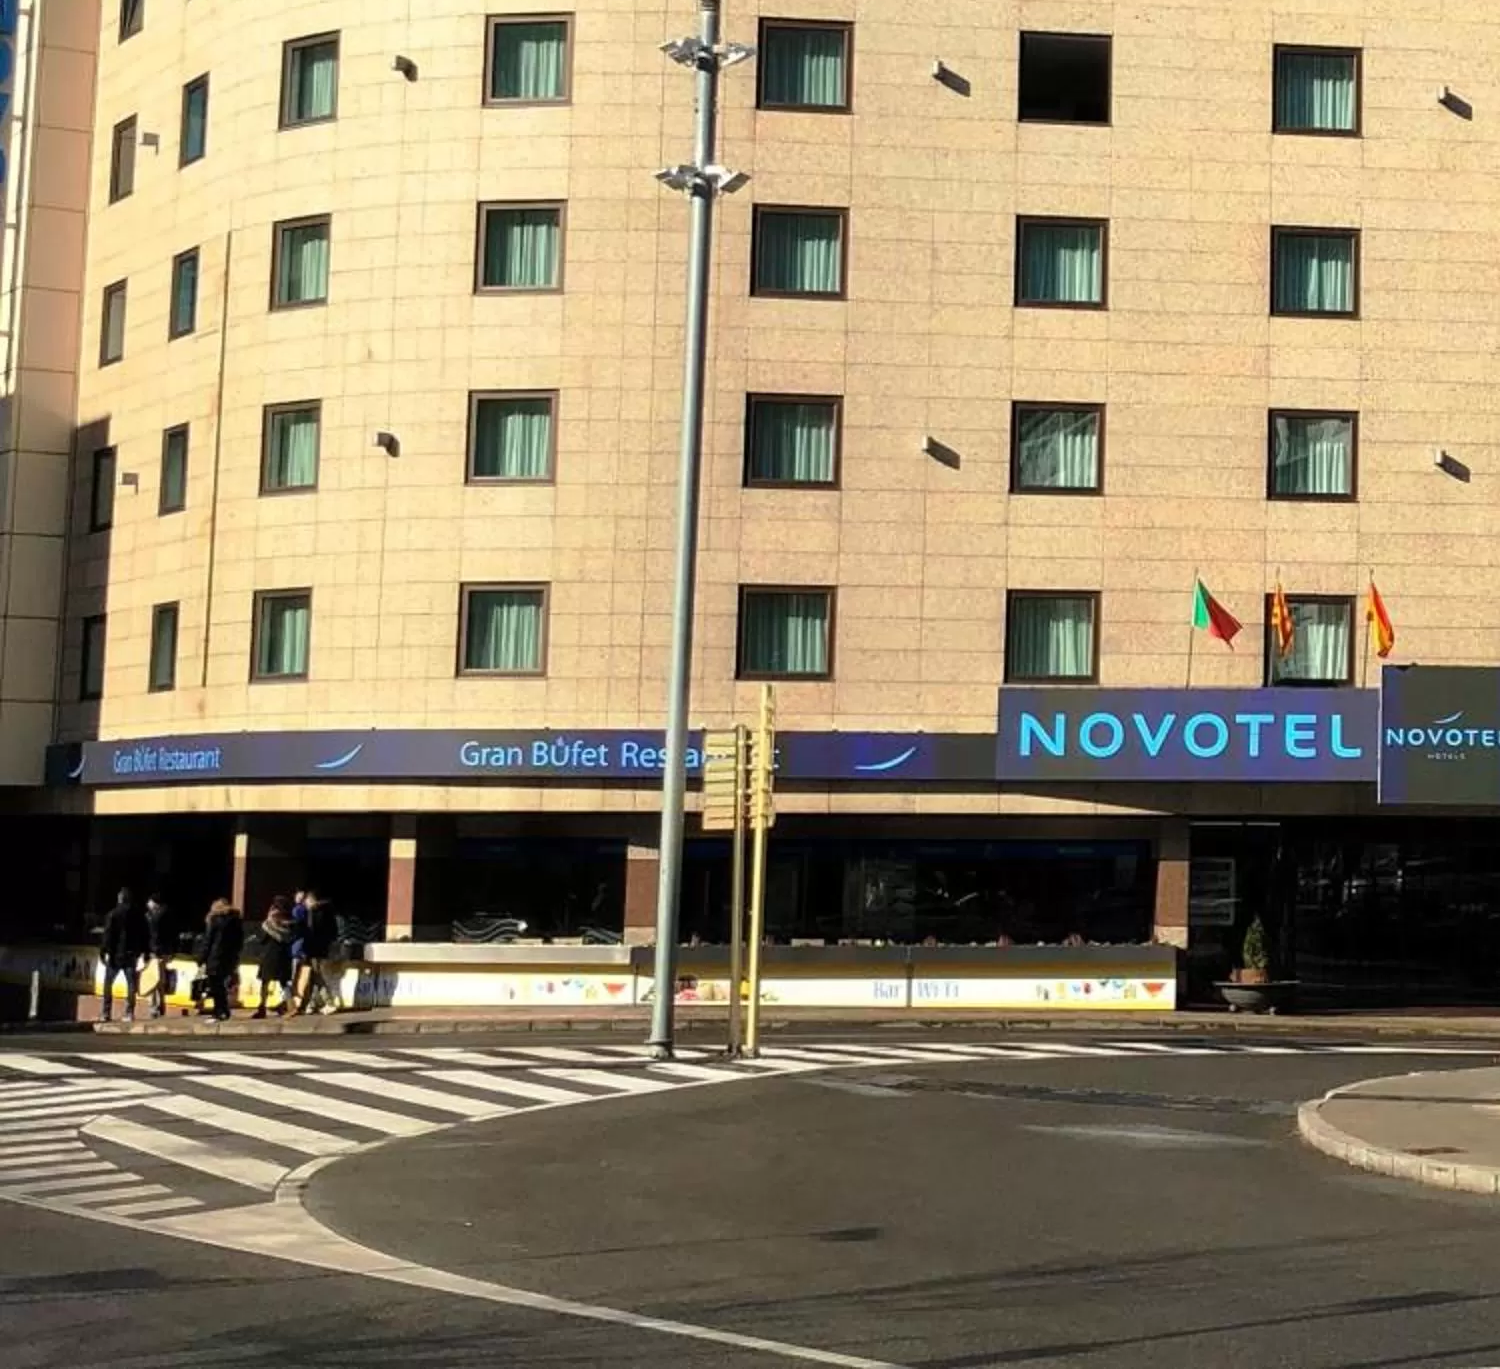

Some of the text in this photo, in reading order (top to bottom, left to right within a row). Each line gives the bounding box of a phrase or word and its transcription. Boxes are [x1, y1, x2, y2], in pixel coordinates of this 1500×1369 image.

[1019, 712, 1362, 758] NOVOTEL
[158, 746, 221, 771] Restaurant
[460, 740, 523, 767] Gran
